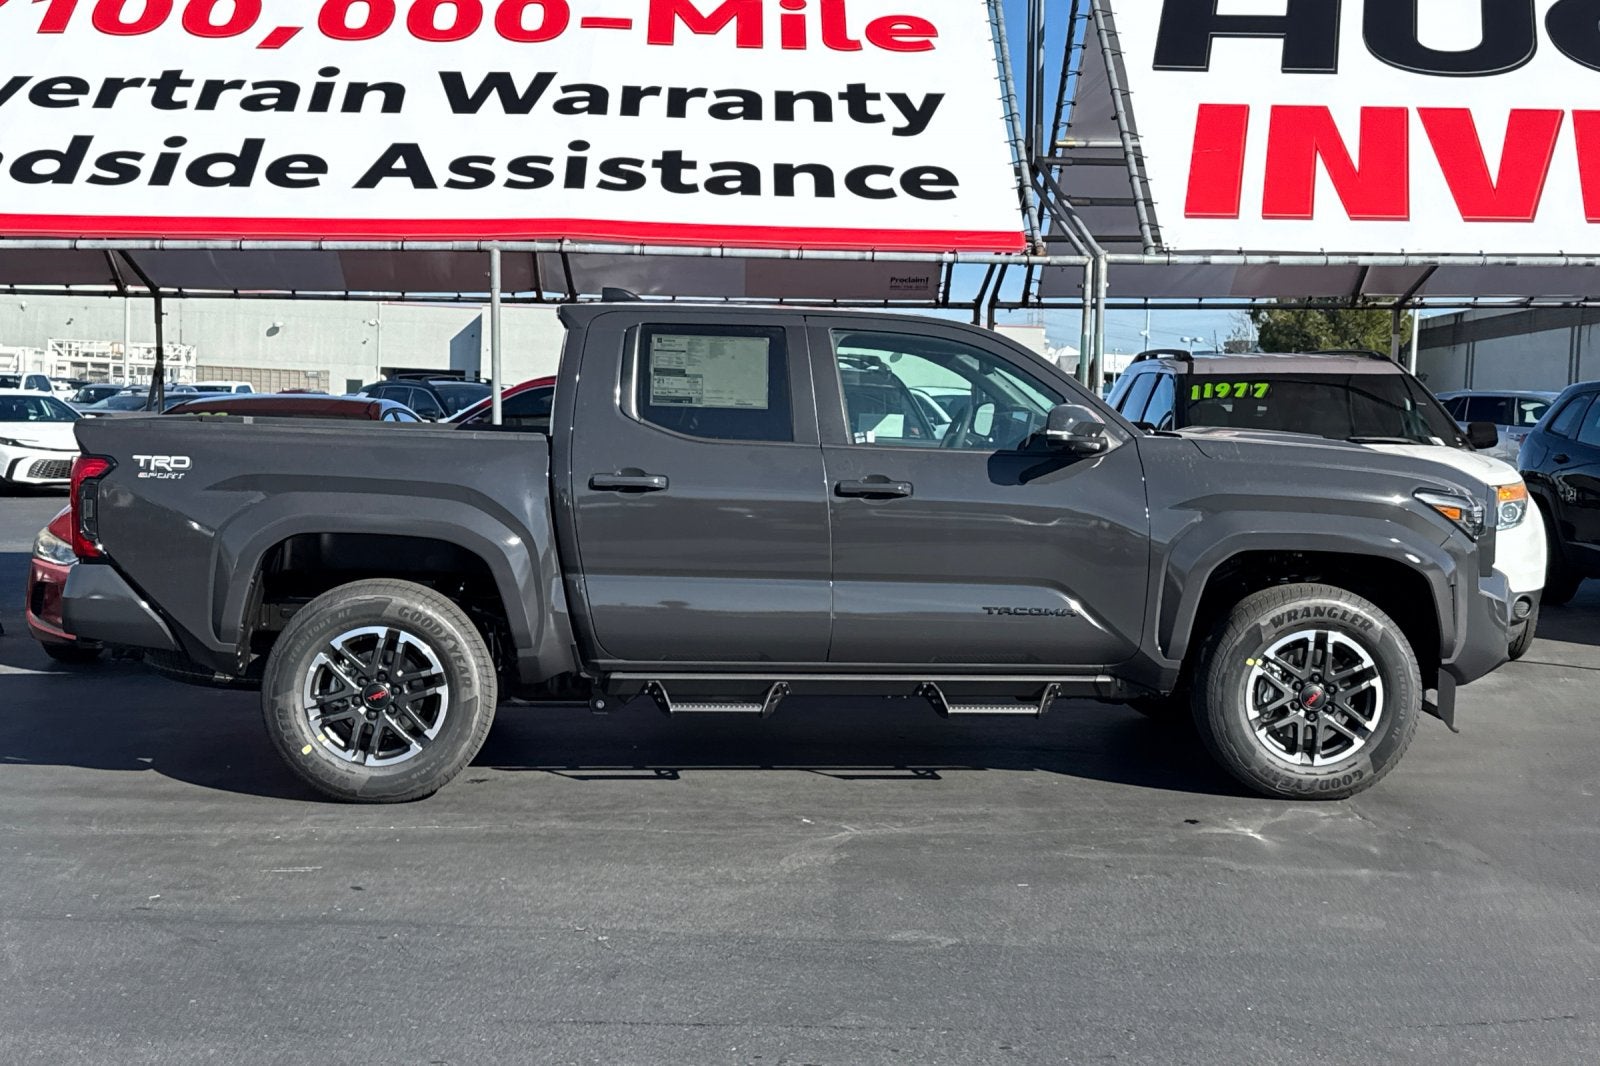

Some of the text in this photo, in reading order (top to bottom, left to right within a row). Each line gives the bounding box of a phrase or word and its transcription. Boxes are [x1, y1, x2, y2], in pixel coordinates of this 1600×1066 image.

[0, 0, 938, 53] 100,000-Mile
[438, 71, 945, 137] Warranty
[0, 135, 960, 200] dside Assistance
[1191, 382, 1270, 400] 11977
[132, 454, 191, 471] TRD
[982, 606, 1077, 617] TACOMA
[1269, 605, 1374, 634] WRANGLER
